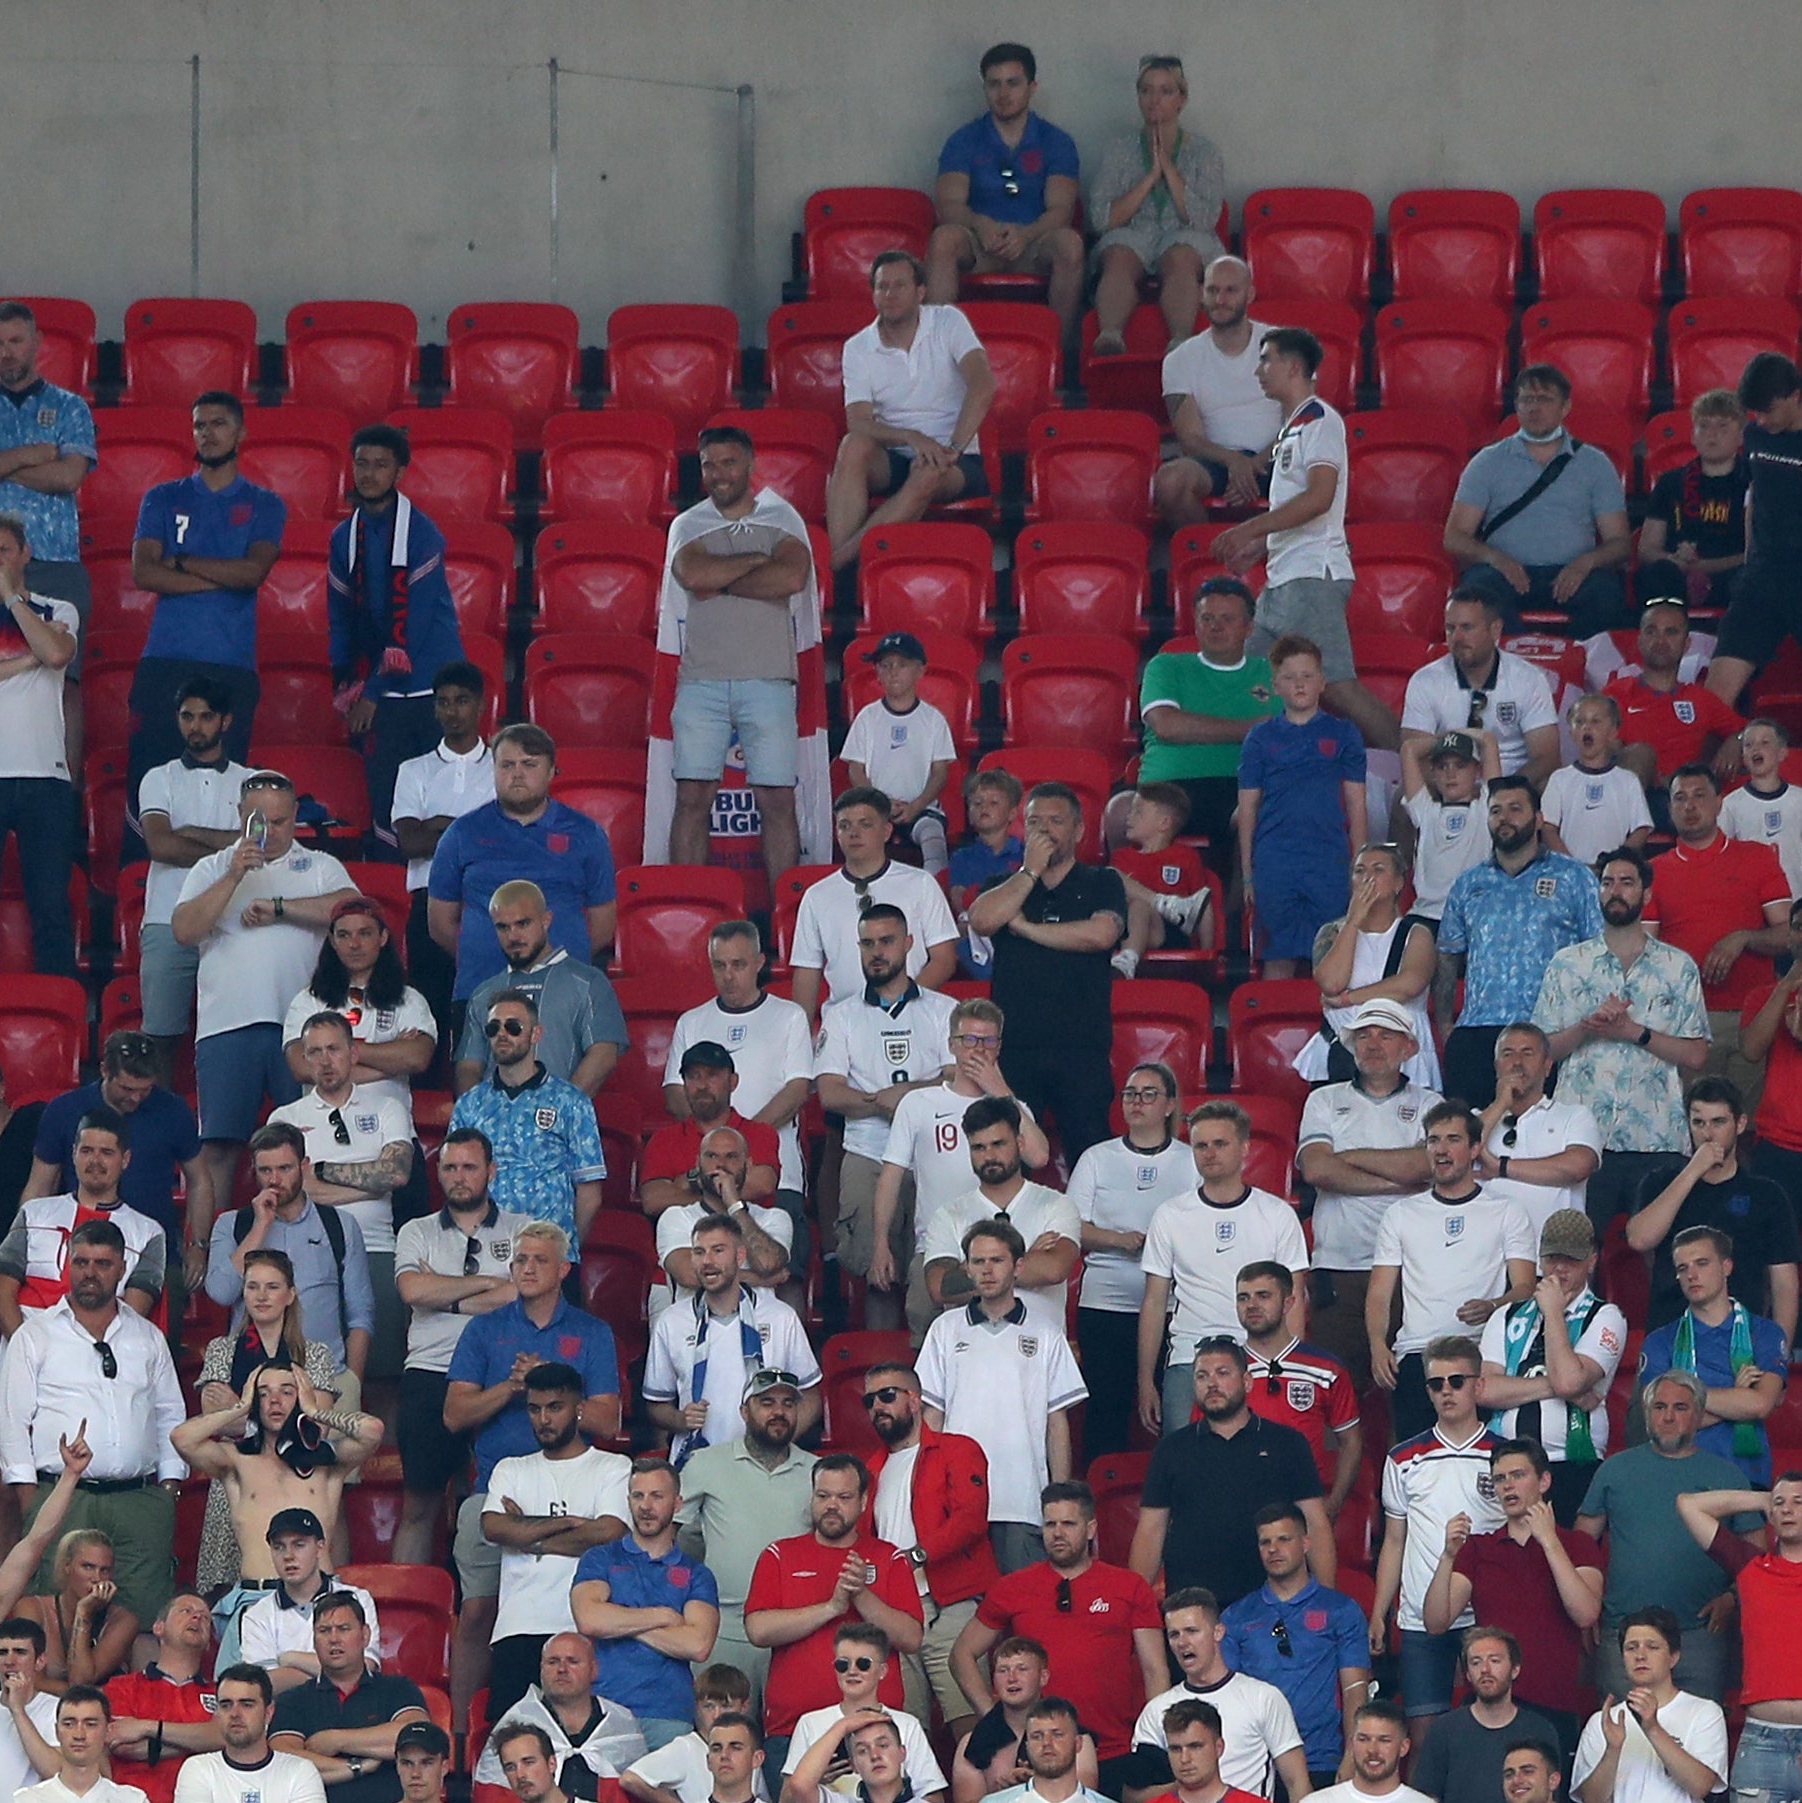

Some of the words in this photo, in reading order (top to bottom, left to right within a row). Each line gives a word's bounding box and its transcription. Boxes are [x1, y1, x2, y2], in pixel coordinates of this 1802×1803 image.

[175, 514, 189, 544] 7
[715, 792, 755, 813] BU
[935, 1123, 958, 1153] 19
